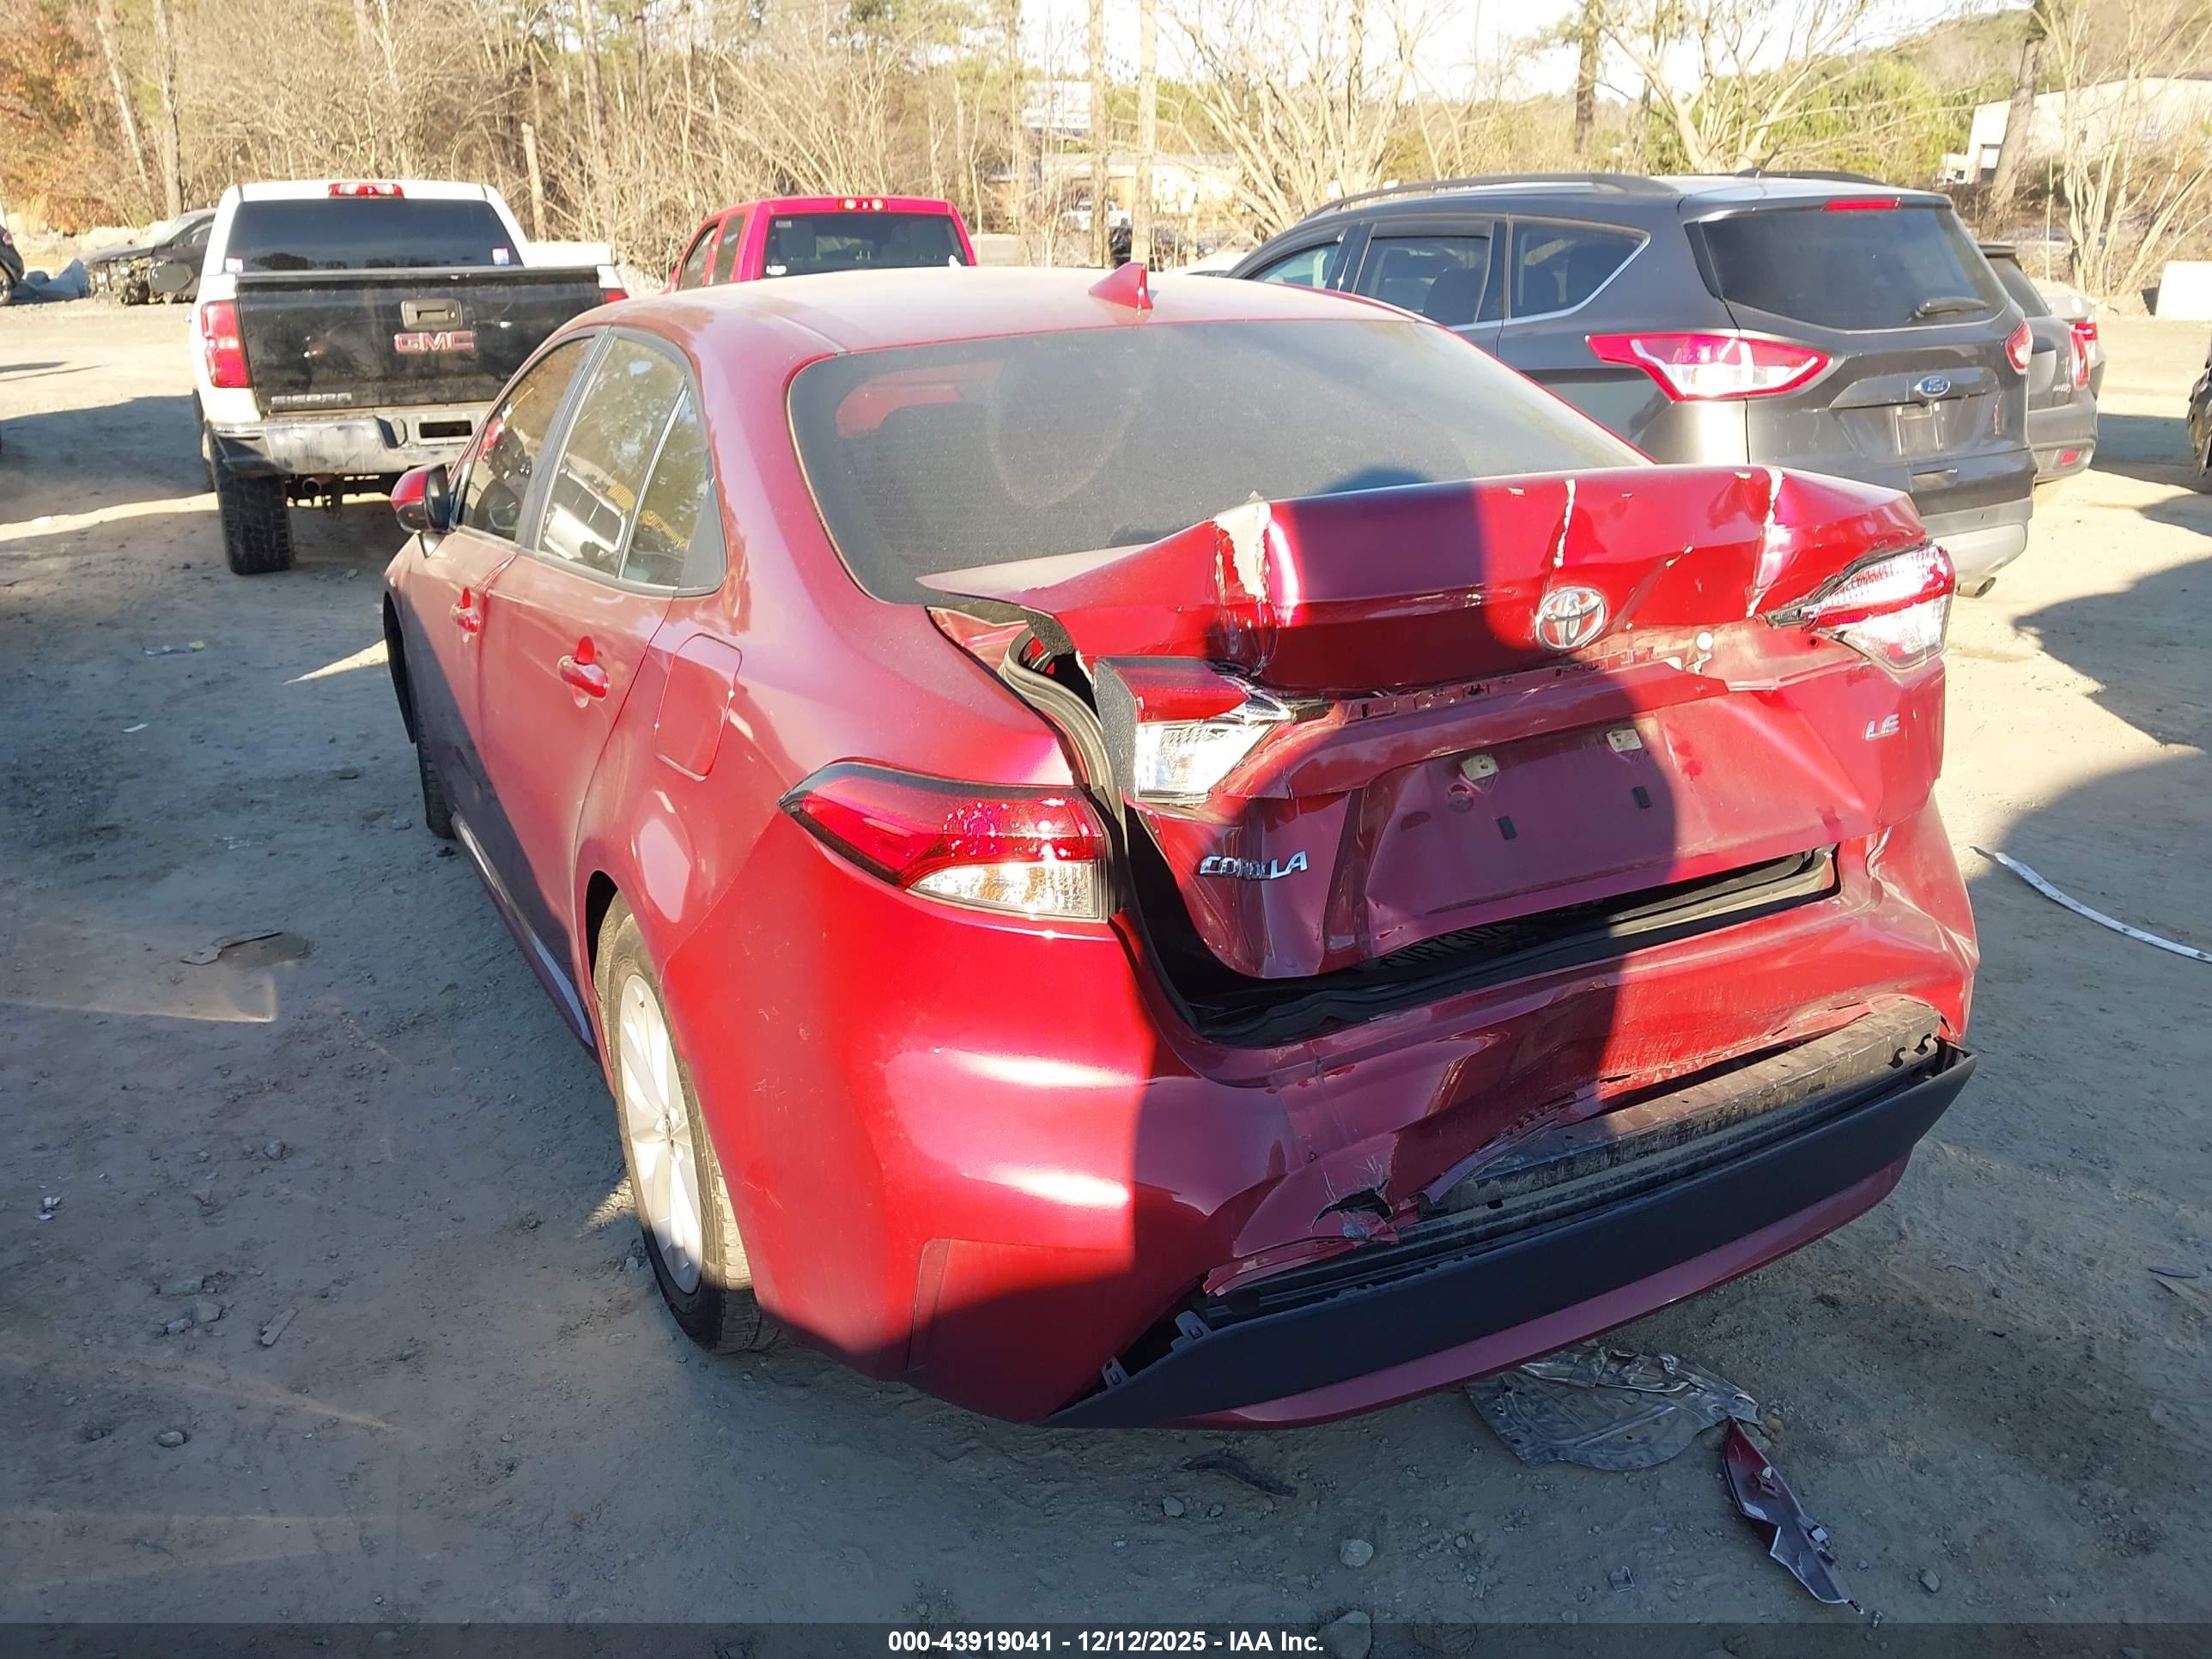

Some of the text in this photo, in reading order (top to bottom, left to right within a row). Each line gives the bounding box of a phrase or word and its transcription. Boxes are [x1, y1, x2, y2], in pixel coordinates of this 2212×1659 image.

[394, 330, 475, 352] GMC
[1864, 713, 1900, 742] LE
[1199, 851, 1309, 881] COROLLA
